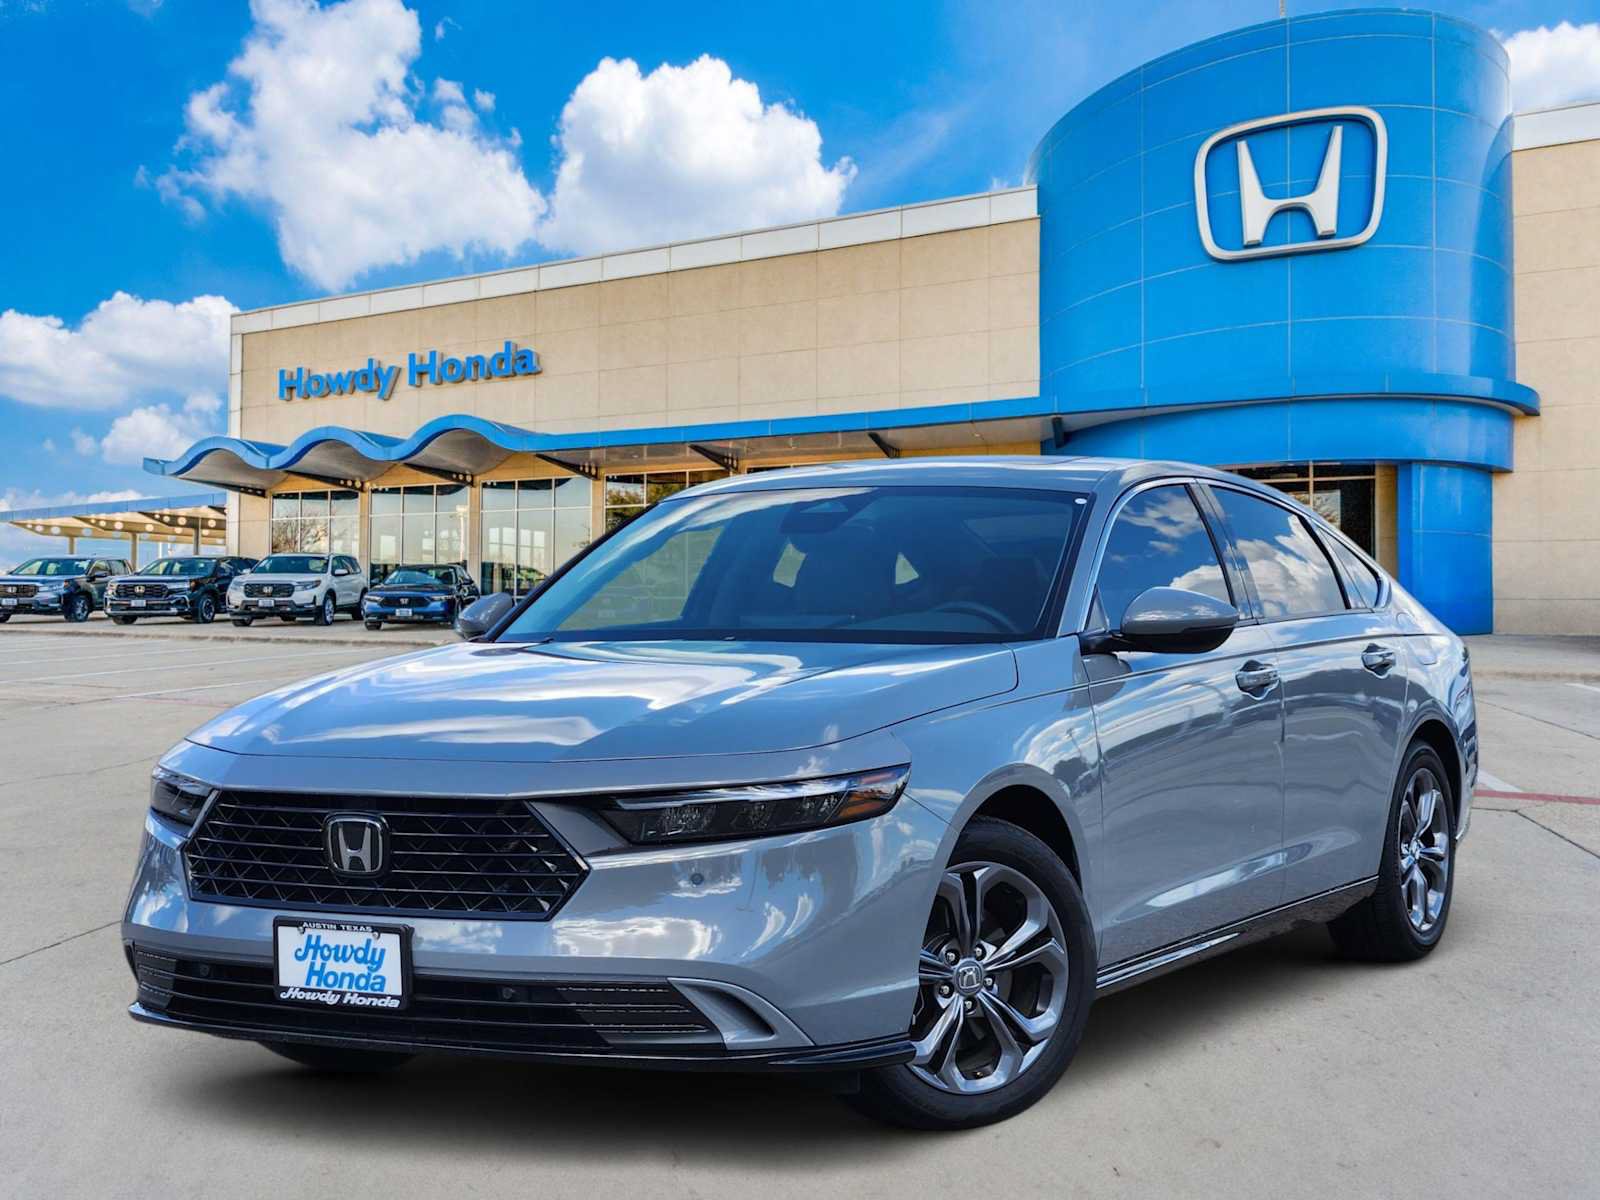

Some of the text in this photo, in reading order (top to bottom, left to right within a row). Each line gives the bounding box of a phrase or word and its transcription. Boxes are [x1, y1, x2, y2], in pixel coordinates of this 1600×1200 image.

[278, 340, 542, 400] Howdy Honda
[302, 921, 373, 933] AUSTIN TEXAS
[294, 934, 386, 972] Howdy
[304, 961, 386, 992] Honda
[280, 987, 400, 1008] Howdy Honda
